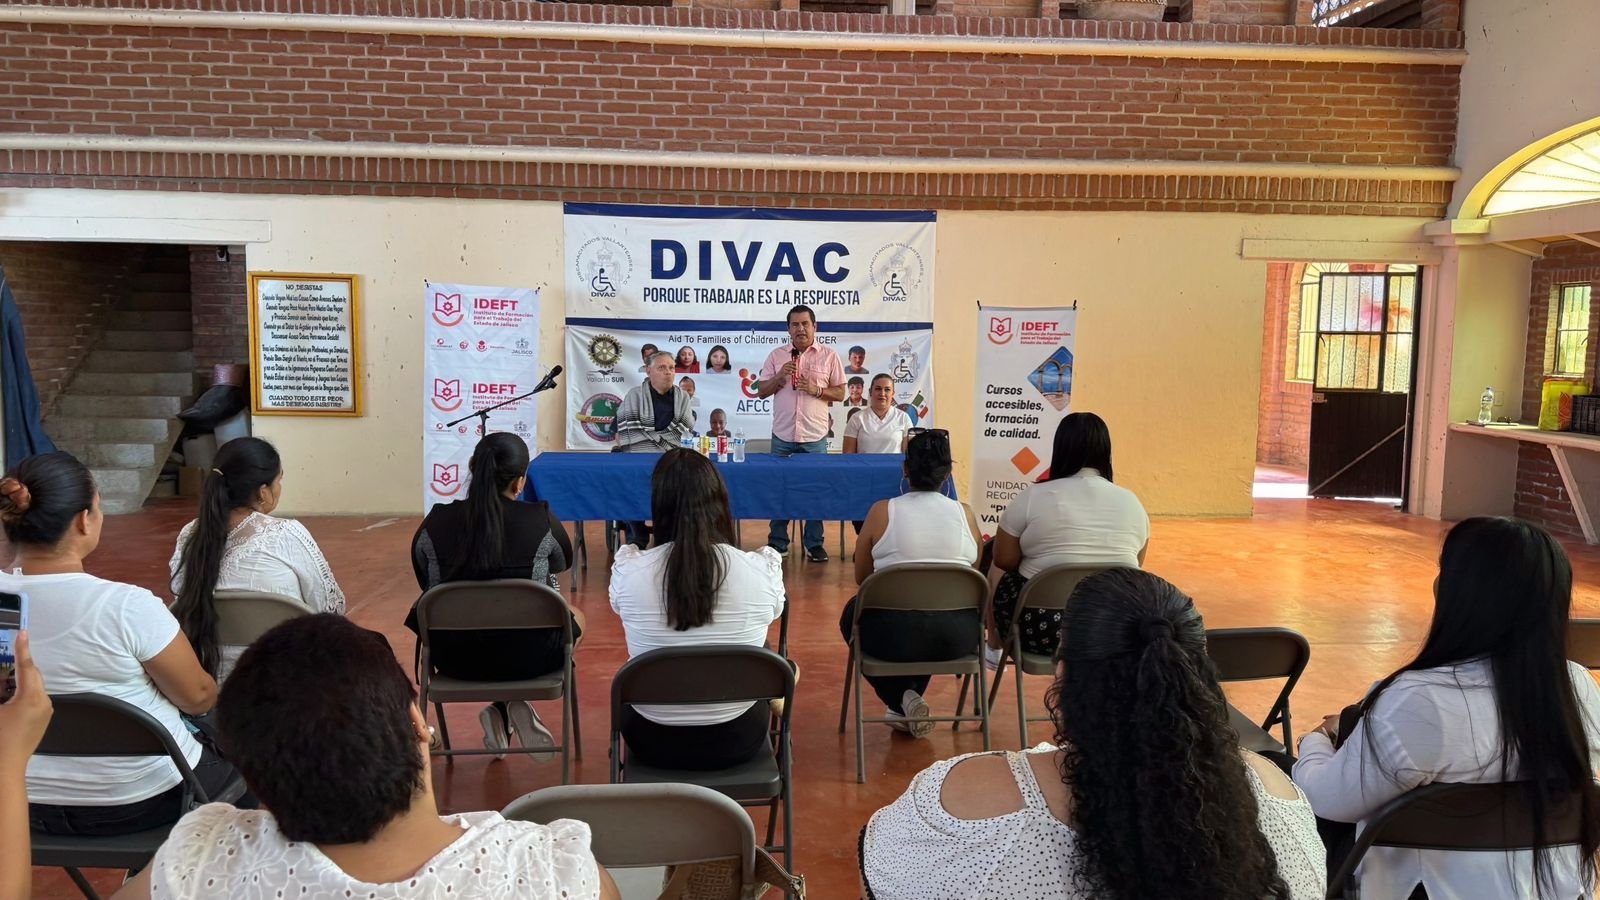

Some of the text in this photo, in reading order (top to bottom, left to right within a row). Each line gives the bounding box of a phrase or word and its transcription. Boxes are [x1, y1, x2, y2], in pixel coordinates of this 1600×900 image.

[651, 239, 850, 283] DIVAC
[643, 287, 860, 305] PORQUE TRABAJAR ES LA RESPUESTA
[473, 298, 518, 311] IDEFT
[1021, 322, 1059, 331] IDEFT
[668, 335, 682, 343] Aid
[685, 335, 694, 343] To
[697, 335, 732, 344] Families
[734, 335, 742, 344] of
[744, 335, 778, 344] Children
[472, 383, 517, 394] IDEFT
[986, 384, 1022, 396] Cursos
[736, 400, 770, 412] AFCC
[986, 400, 1044, 412] accesibles,
[985, 413, 1039, 425] formación
[984, 427, 1041, 440] de calidad.
[986, 480, 1028, 491] UNIDAD
